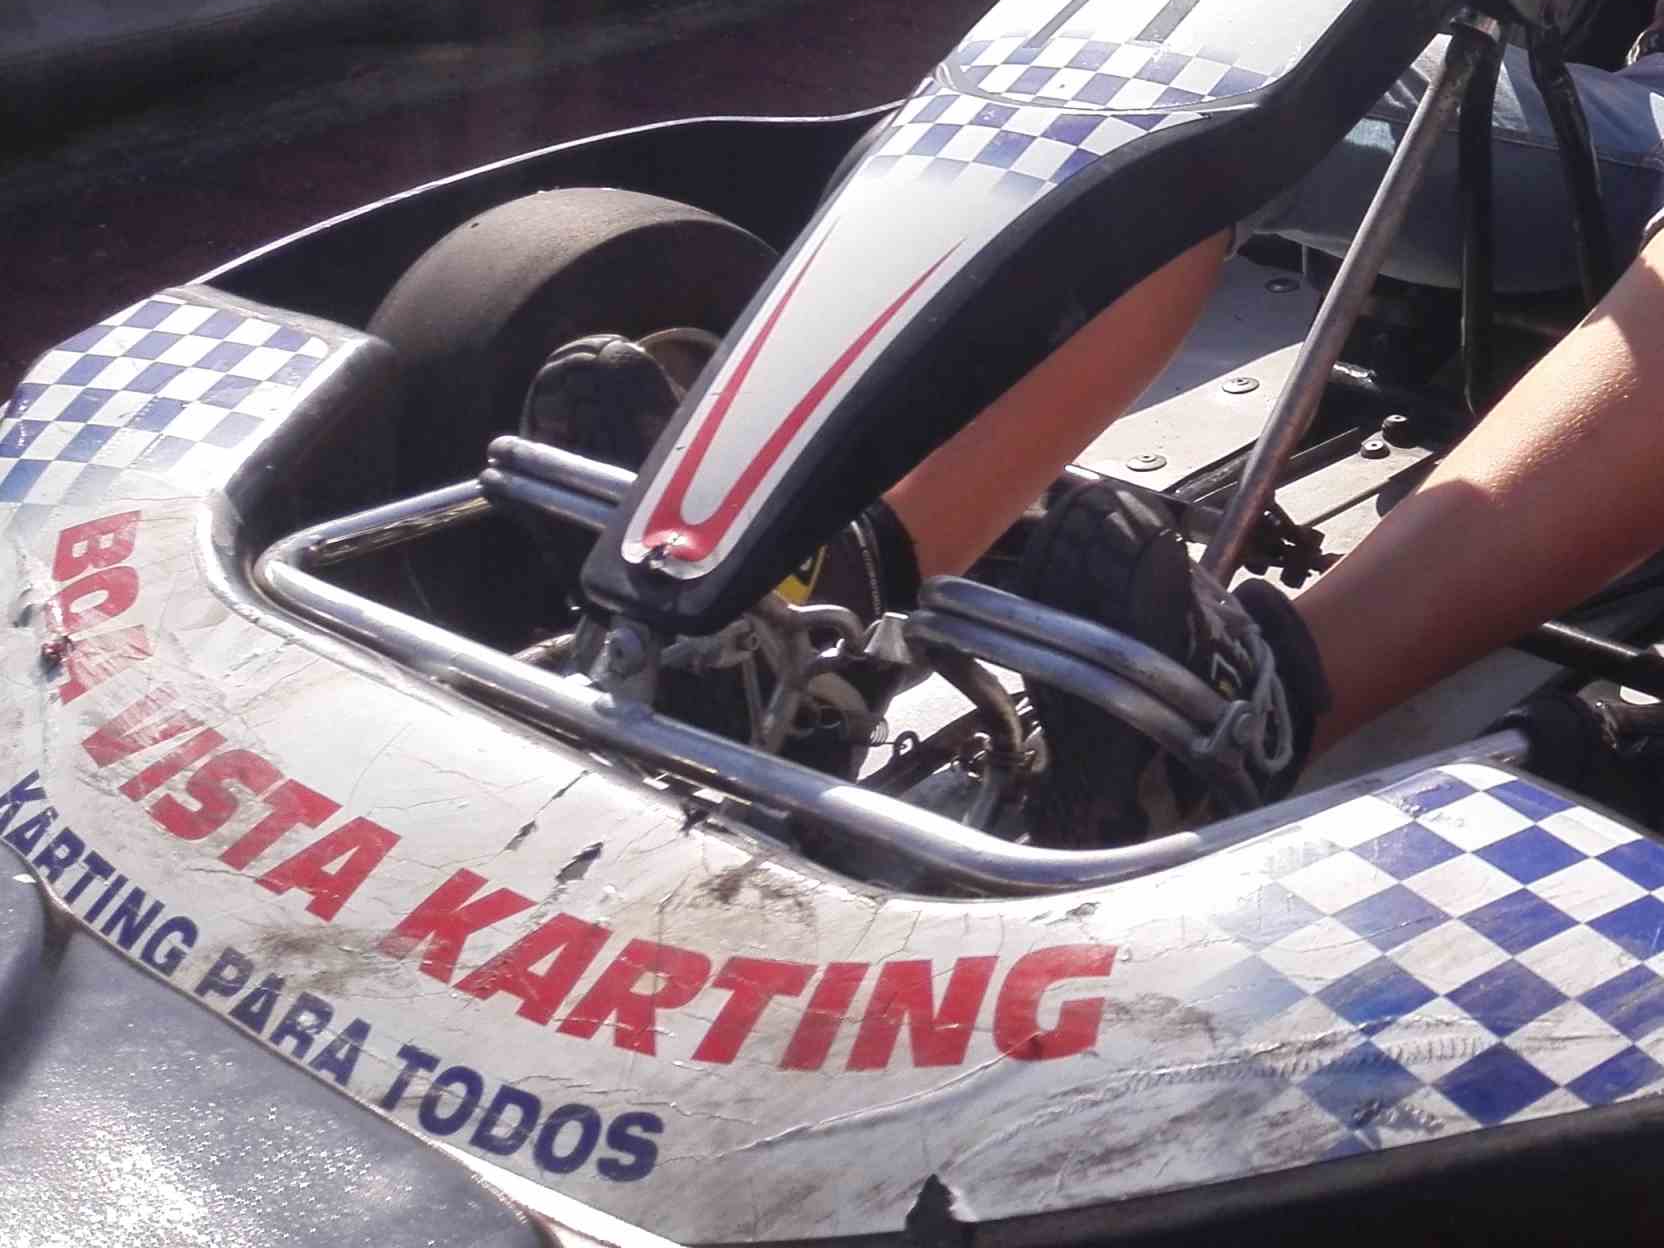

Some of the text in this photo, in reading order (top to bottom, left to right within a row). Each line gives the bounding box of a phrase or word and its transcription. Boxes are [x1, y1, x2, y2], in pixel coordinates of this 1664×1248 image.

[0, 769, 664, 1182] KARTING PARA TODOS
[81, 686, 400, 922] VISTA
[380, 867, 1118, 1071] KARTING
